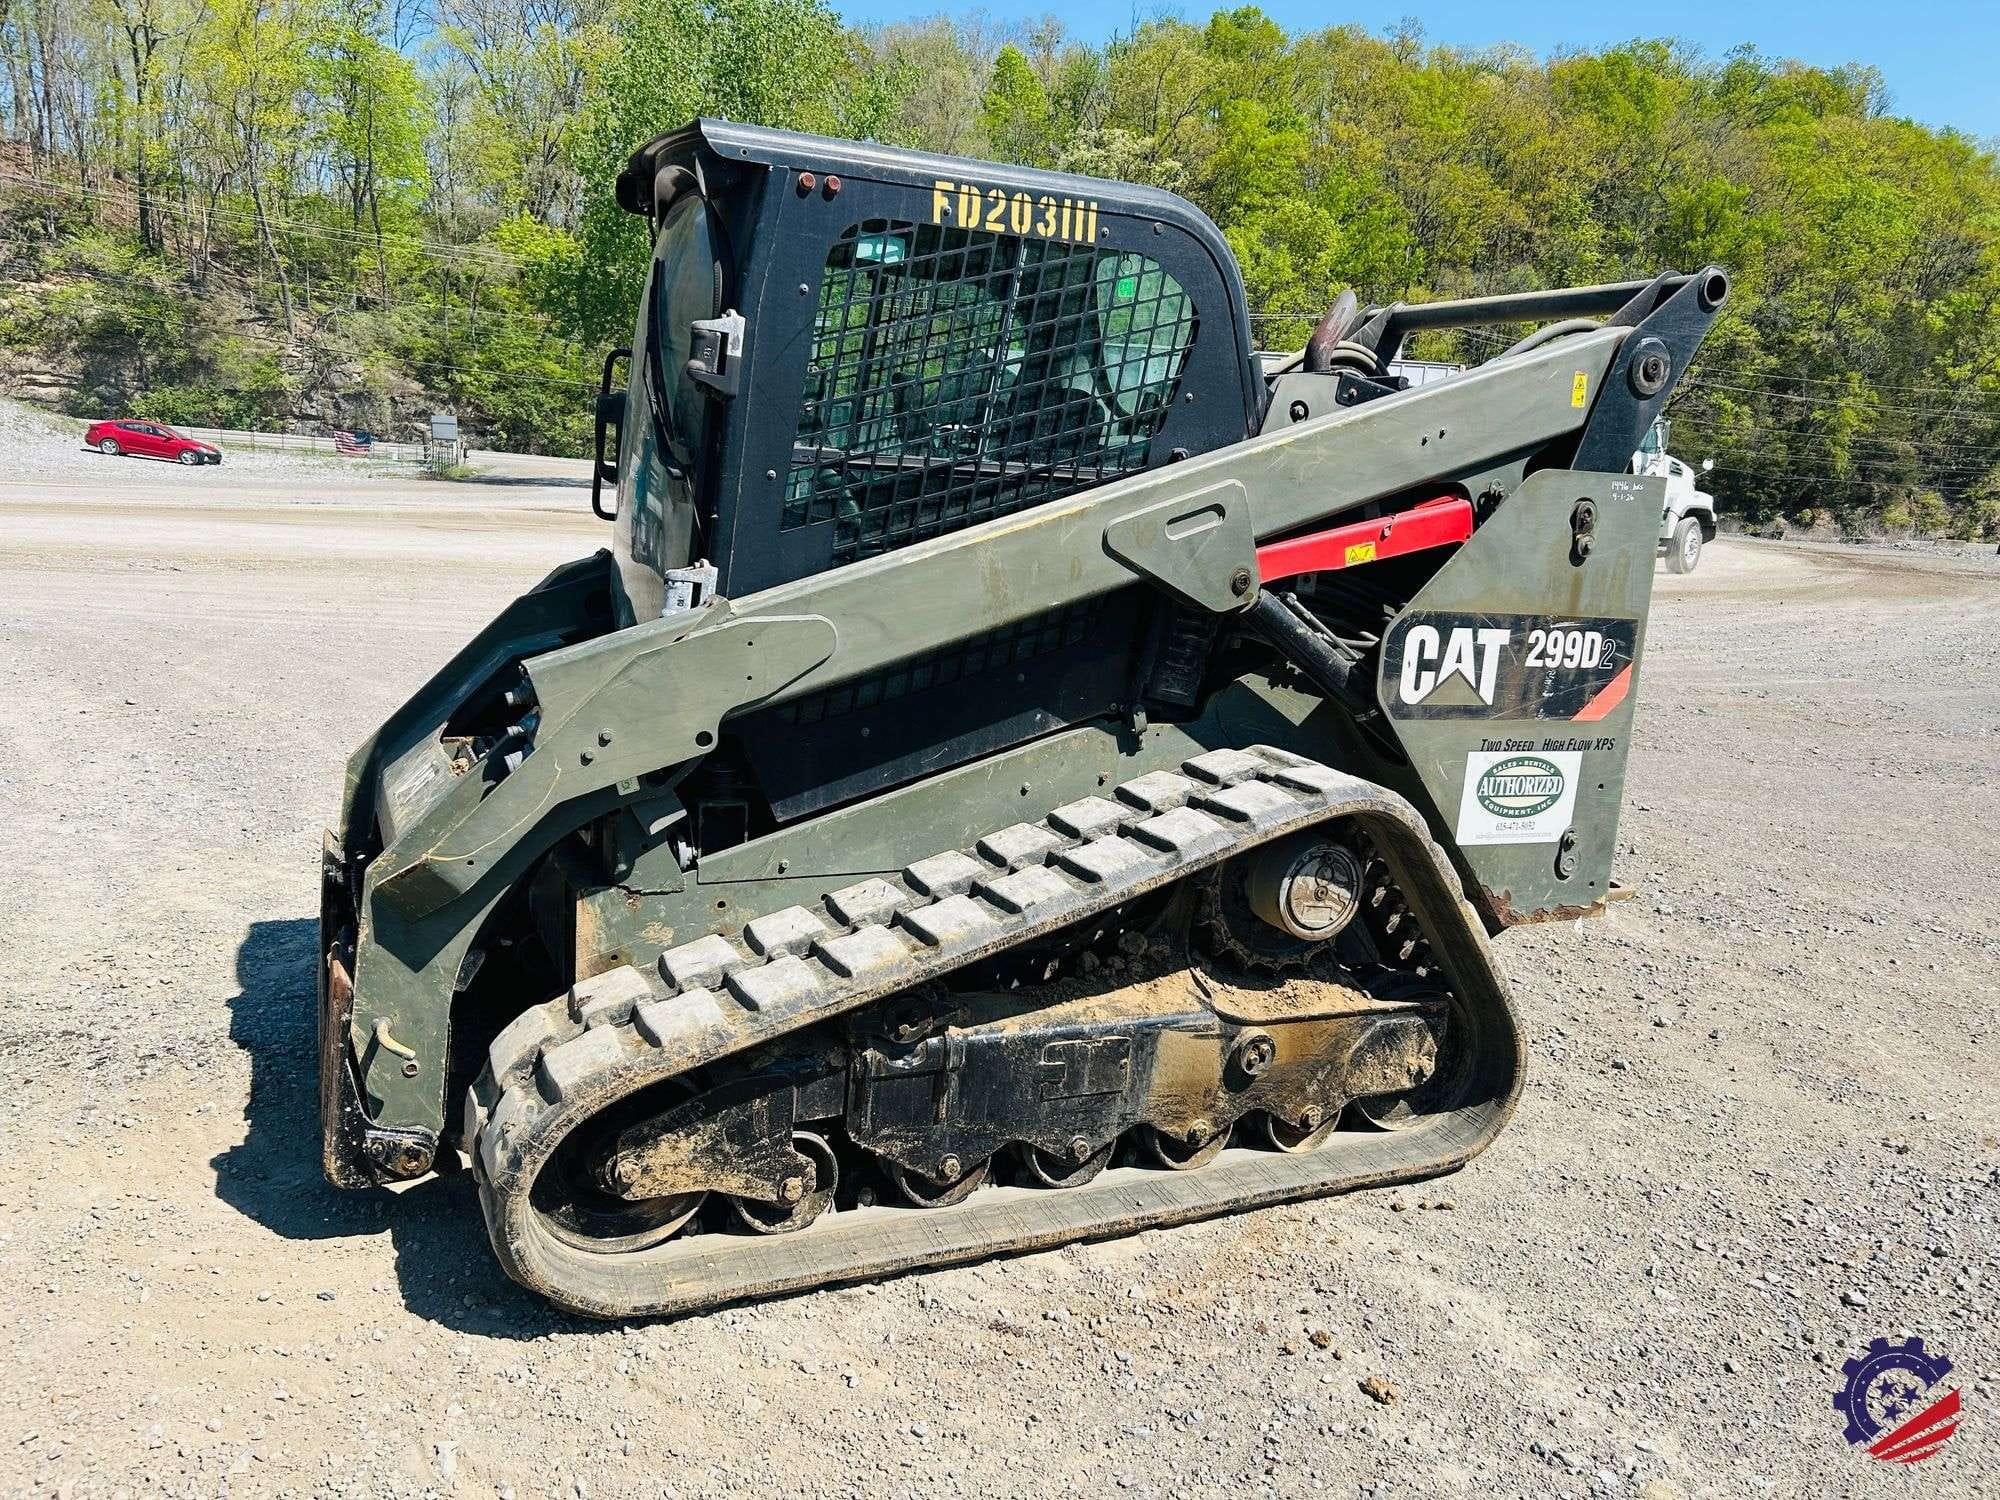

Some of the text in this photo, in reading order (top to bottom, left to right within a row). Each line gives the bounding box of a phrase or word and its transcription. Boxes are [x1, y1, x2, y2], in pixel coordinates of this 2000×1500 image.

[1399, 624, 1511, 706] CAT
[1593, 737, 1615, 751] XPS
[1477, 775, 1563, 797] AUTHORIZED
